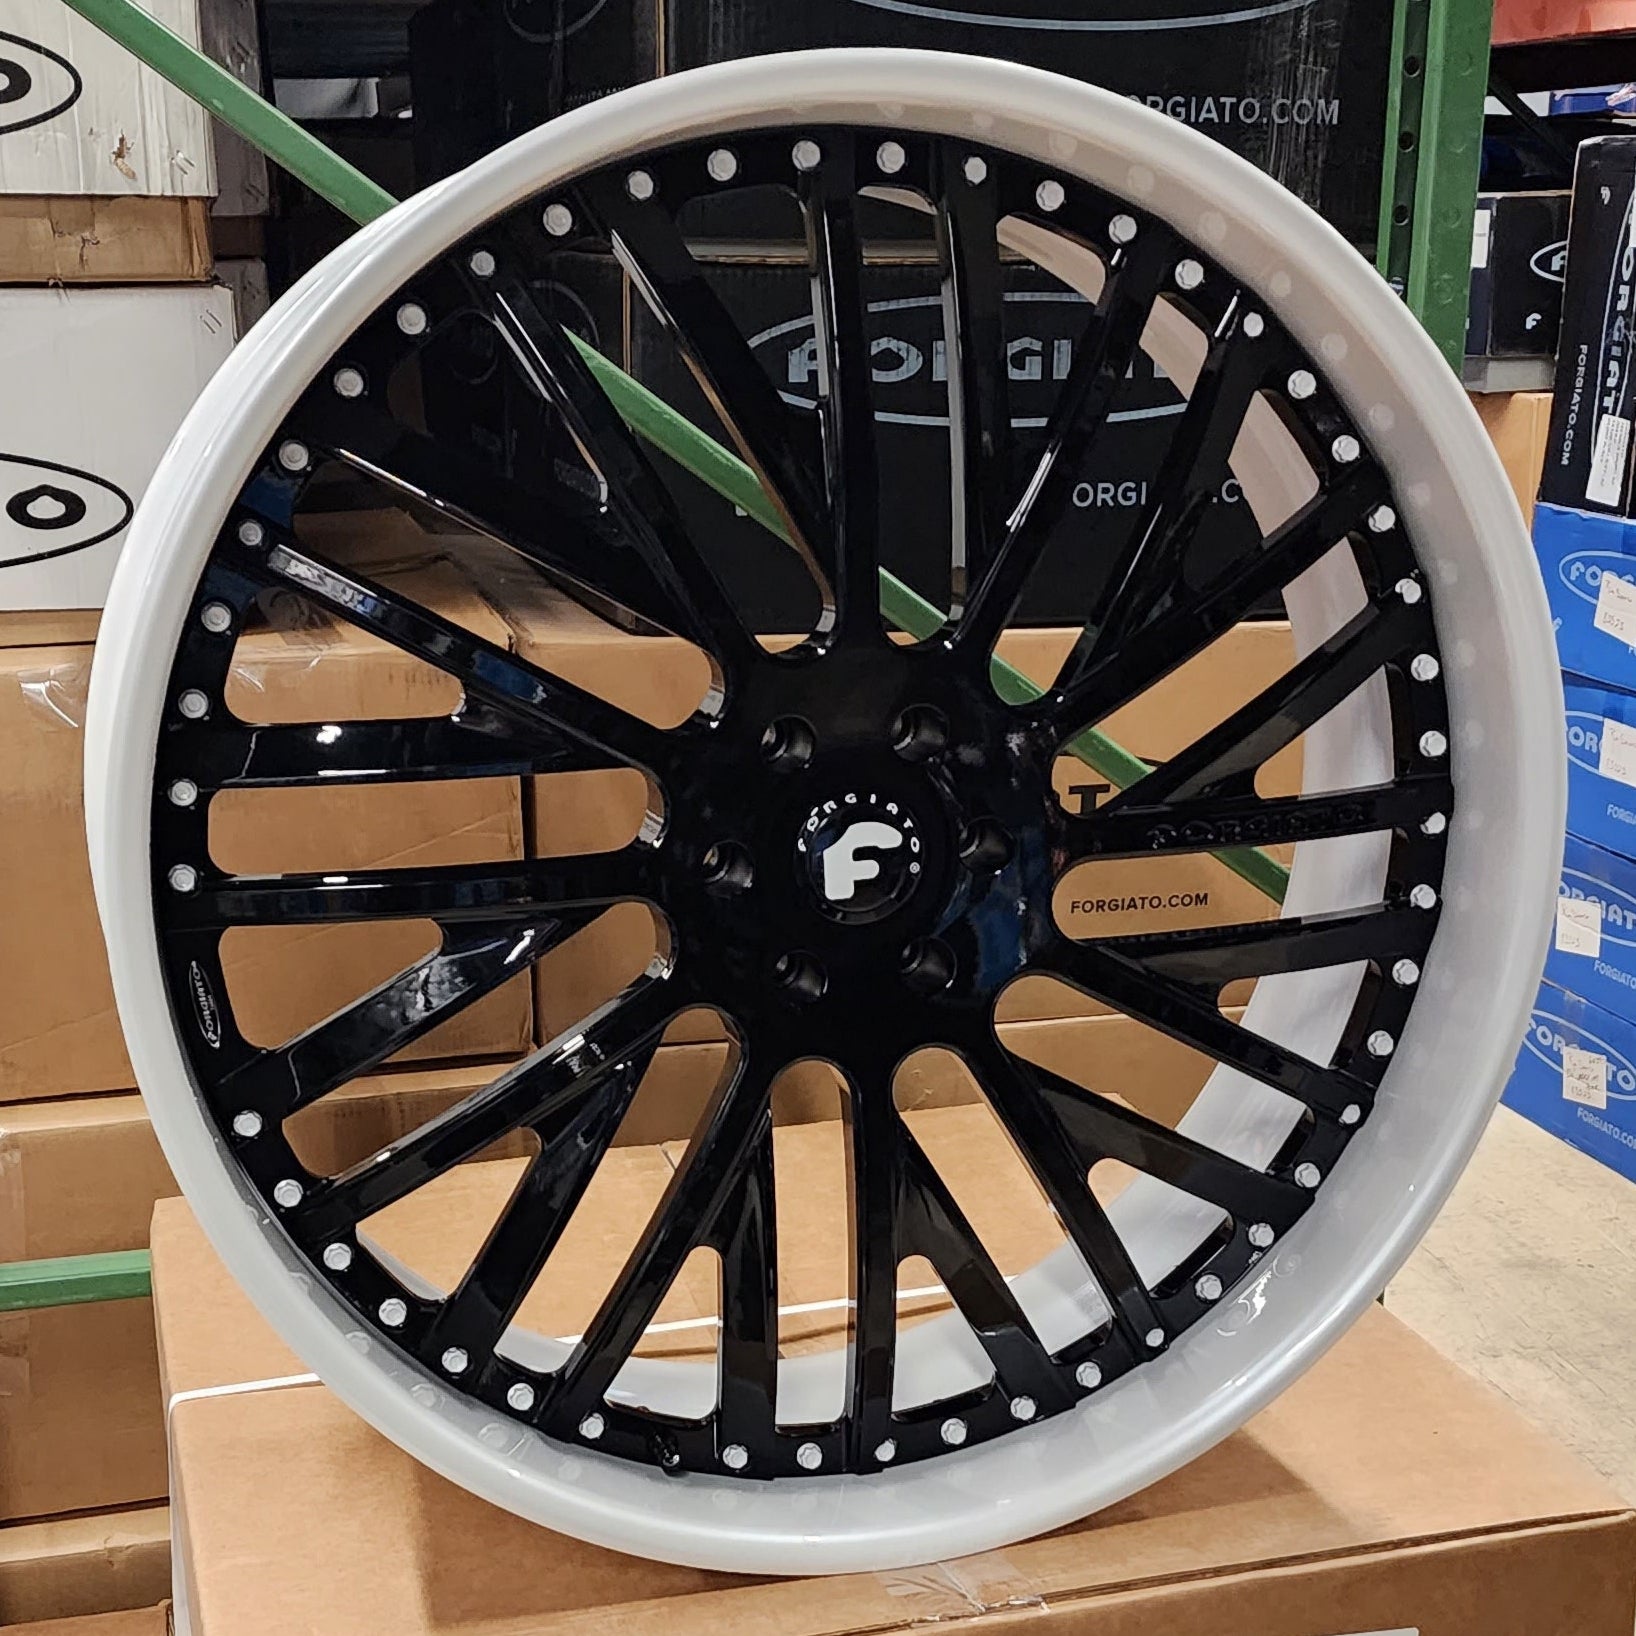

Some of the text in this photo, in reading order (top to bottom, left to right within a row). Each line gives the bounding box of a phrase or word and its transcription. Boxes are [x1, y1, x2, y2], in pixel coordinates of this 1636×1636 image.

[1561, 344, 1588, 466] FORGIATO.COM
[823, 821, 903, 901] F
[1070, 892, 1209, 914] FORGIATO.COM
